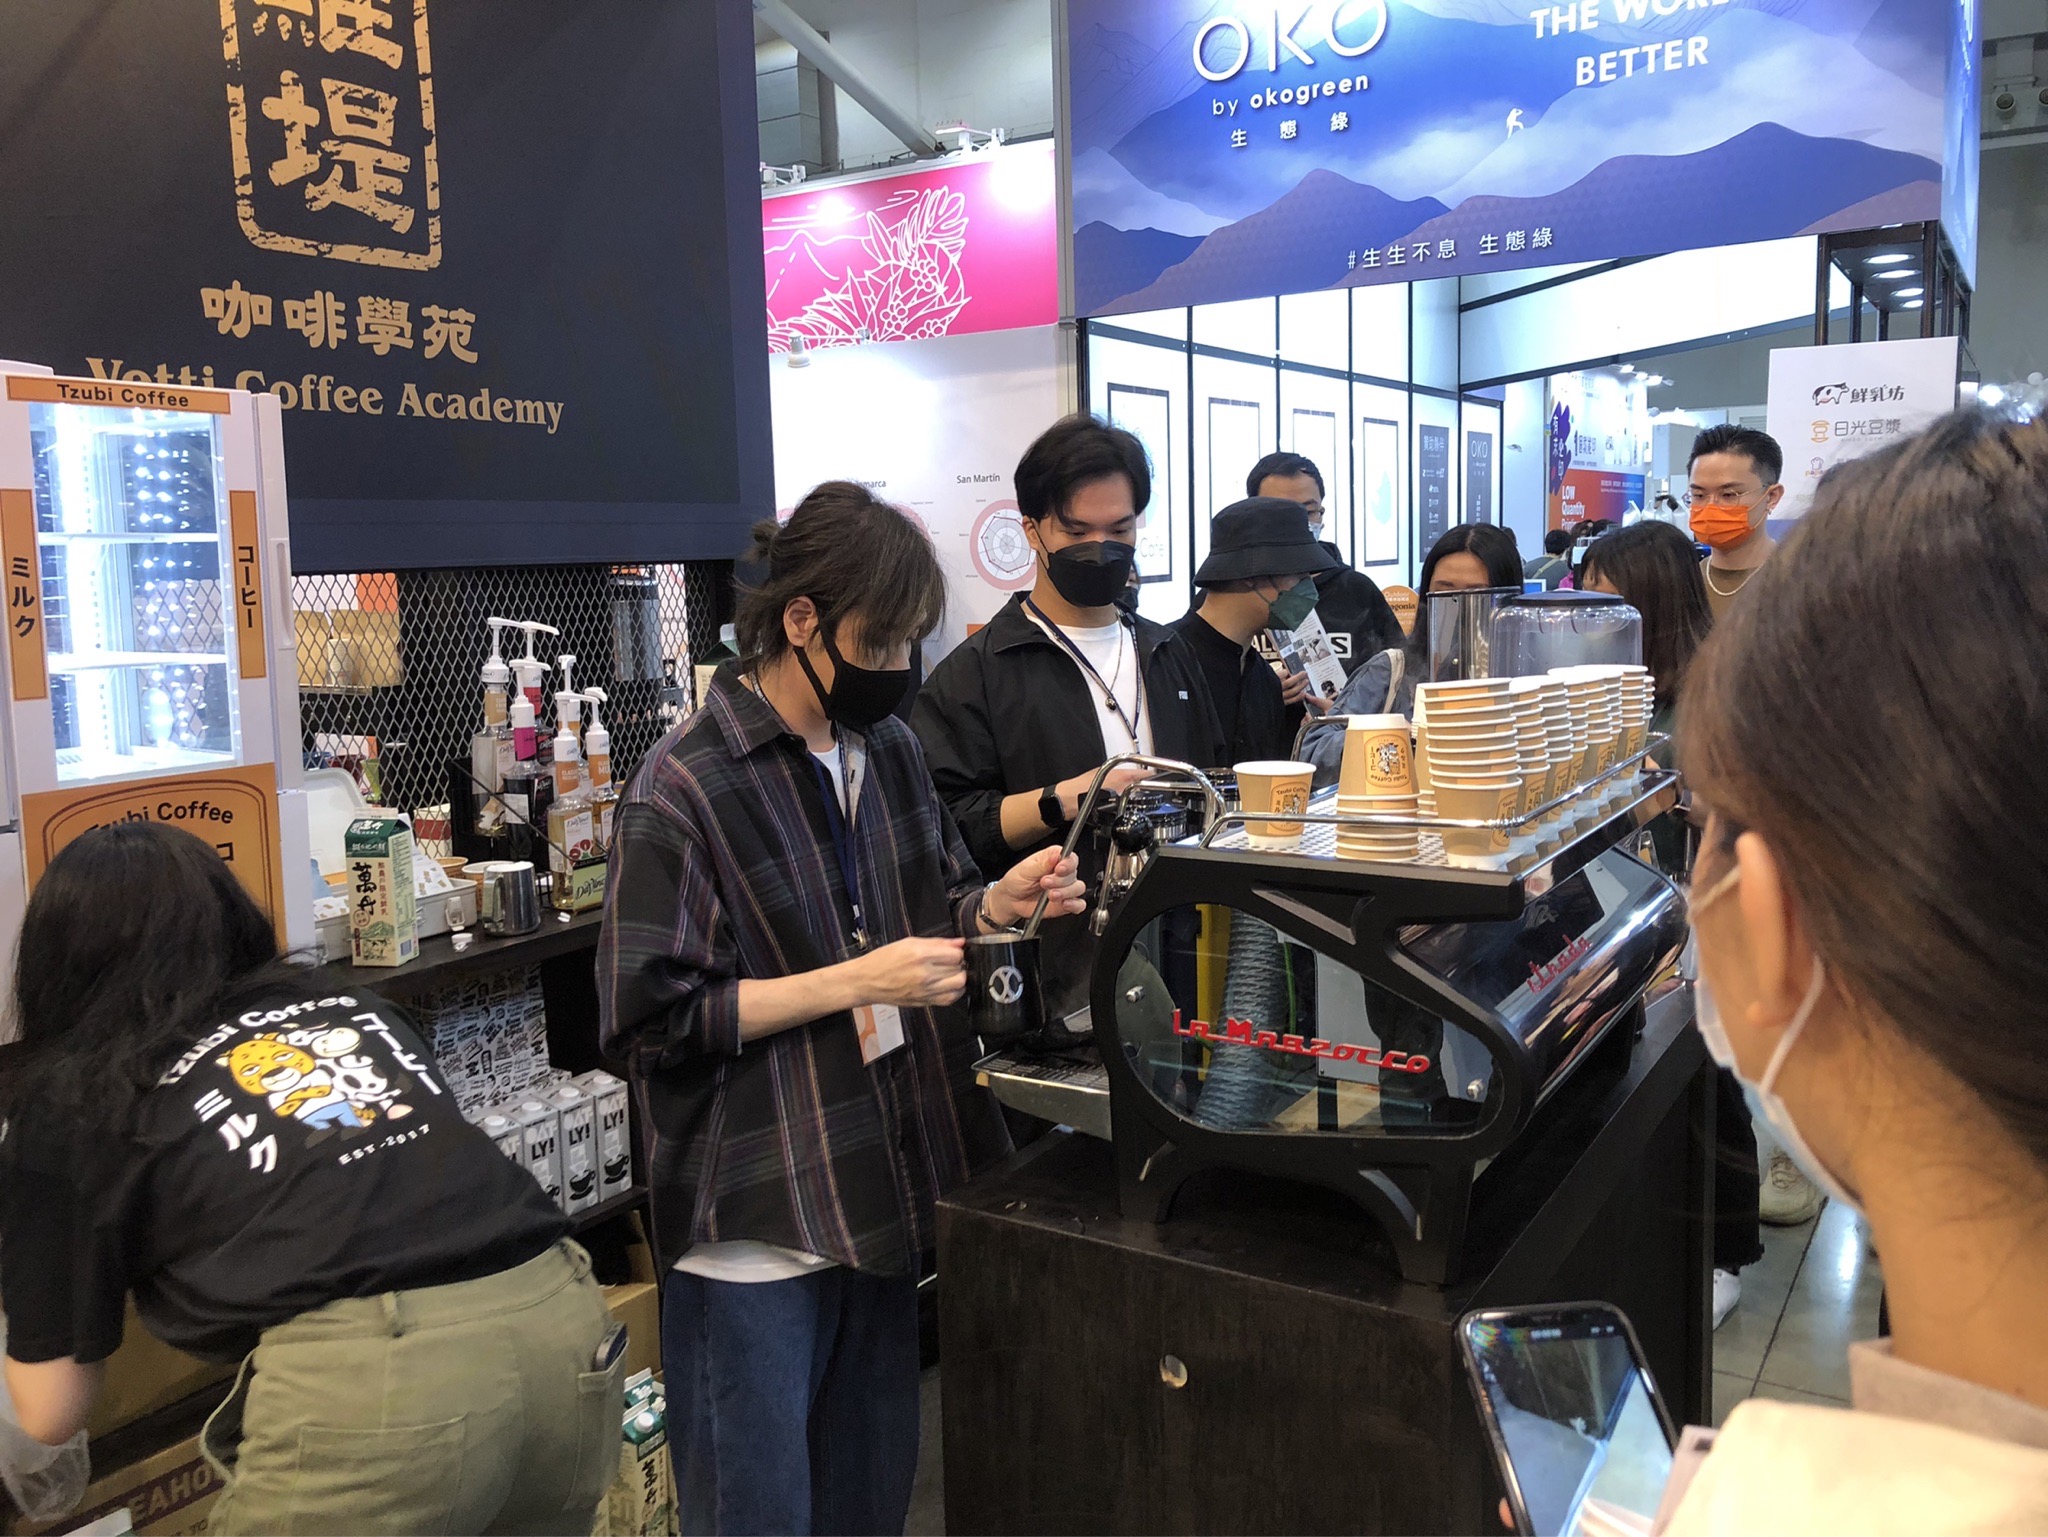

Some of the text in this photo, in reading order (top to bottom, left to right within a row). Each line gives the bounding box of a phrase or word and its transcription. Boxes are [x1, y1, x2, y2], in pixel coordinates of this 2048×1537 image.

[1530, 1, 1599, 39] THE
[1192, 0, 1388, 82] OKO
[1575, 36, 1709, 87] BETTER
[1212, 74, 1369, 117] by okogreen
[1230, 111, 1349, 149] 生態綠
[1347, 226, 1554, 270] #生生不息 生態綠
[200, 279, 479, 365] 咖啡學苑
[56, 383, 190, 408] Tzubi Coffee
[396, 382, 565, 435] Academy
[1850, 383, 1906, 404] 鮮乳坊
[1471, 440, 1489, 459] OKO
[956, 473, 1001, 484] San Martín
[11, 556, 36, 638] ミルク
[237, 545, 258, 629] コーヒー
[156, 800, 234, 824] Coffee
[238, 995, 359, 1029] Coffee
[350, 1011, 443, 1096] コーヒー
[193, 1087, 278, 1174] ミルク
[568, 1122, 591, 1147] LY!
[603, 1108, 625, 1132] LY!
[531, 1137, 555, 1162] LY!
